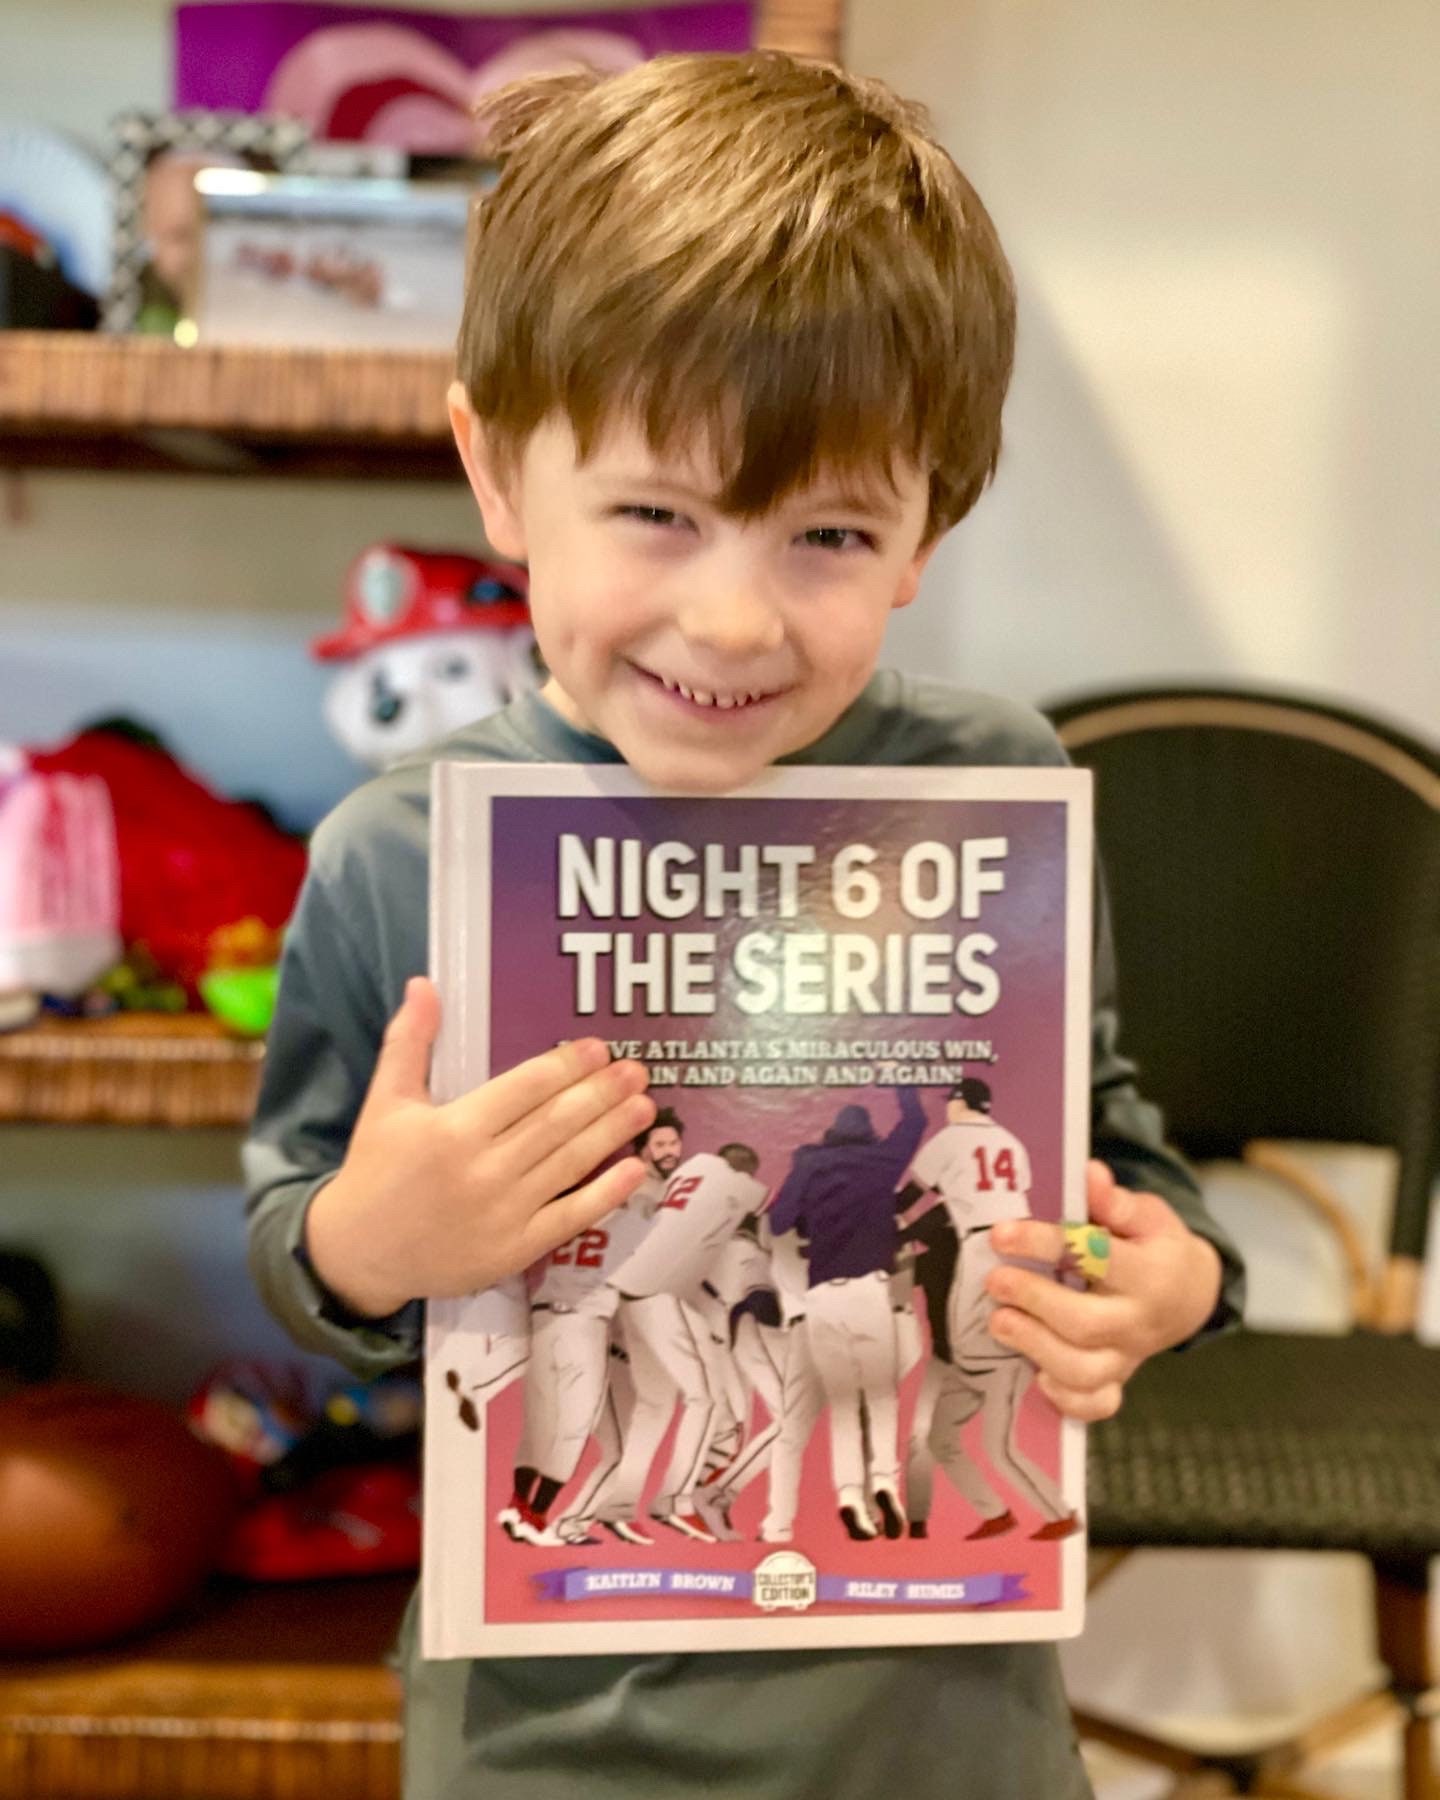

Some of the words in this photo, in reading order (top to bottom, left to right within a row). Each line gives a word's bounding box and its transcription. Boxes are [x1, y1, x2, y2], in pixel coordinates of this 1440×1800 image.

[558, 834, 815, 919] NIGHT
[832, 843, 881, 919] 6
[899, 836, 1009, 919] OF
[560, 932, 716, 1016] THE
[733, 932, 1001, 1016] SERIES
[788, 1040, 940, 1060] MIRACULOUS
[944, 1040, 998, 1062] WIN,
[684, 1065, 735, 1085] AND
[740, 1065, 817, 1085] AGAIN
[823, 1065, 874, 1085] AND
[877, 1065, 963, 1085] AGAIN!
[973, 1146, 1016, 1191] 14
[670, 1573, 736, 1592] BROWN
[760, 1587, 810, 1601] EDITION
